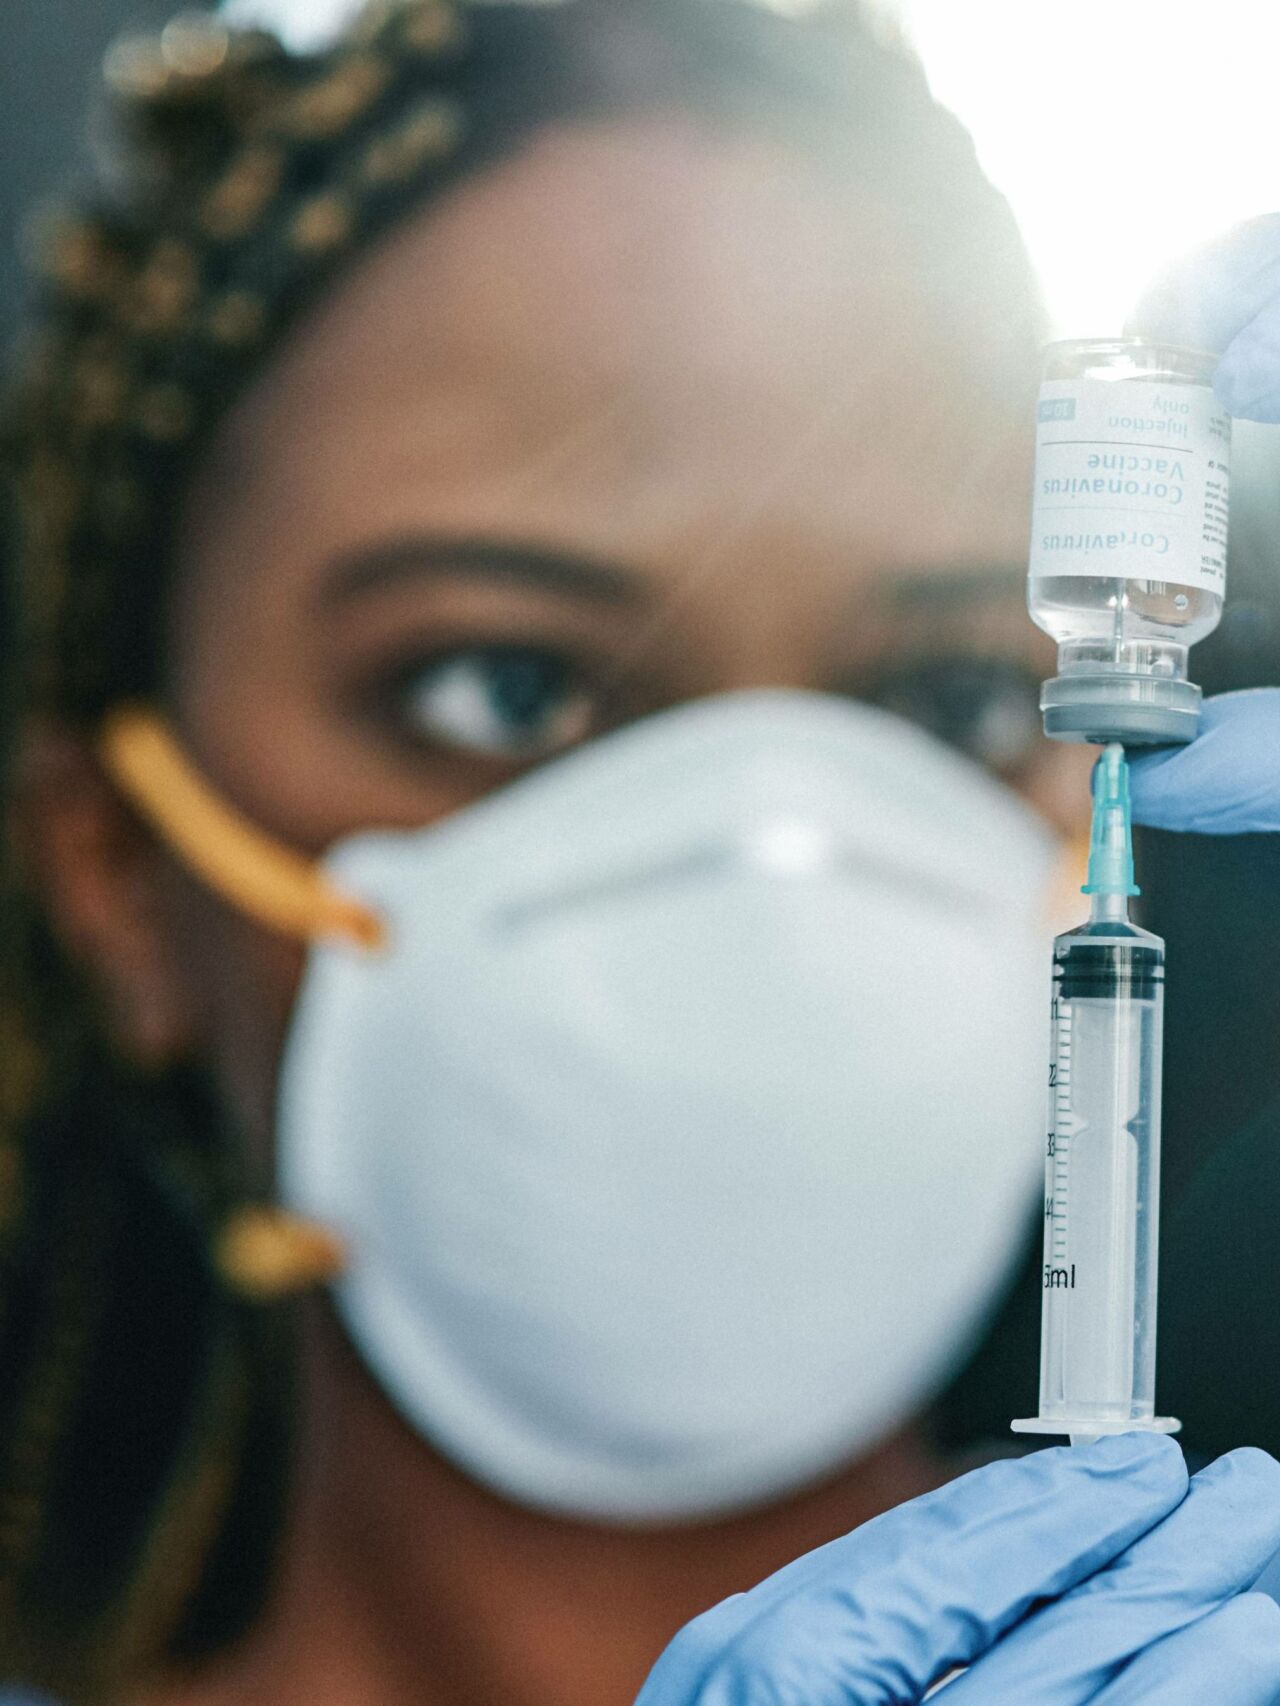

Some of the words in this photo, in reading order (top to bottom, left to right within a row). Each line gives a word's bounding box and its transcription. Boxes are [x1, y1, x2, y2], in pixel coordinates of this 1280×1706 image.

[1153, 393, 1190, 414] only
[1108, 415, 1188, 439] Injection
[1088, 454, 1185, 482] Vaccine
[1043, 477, 1184, 505] Coronavirus
